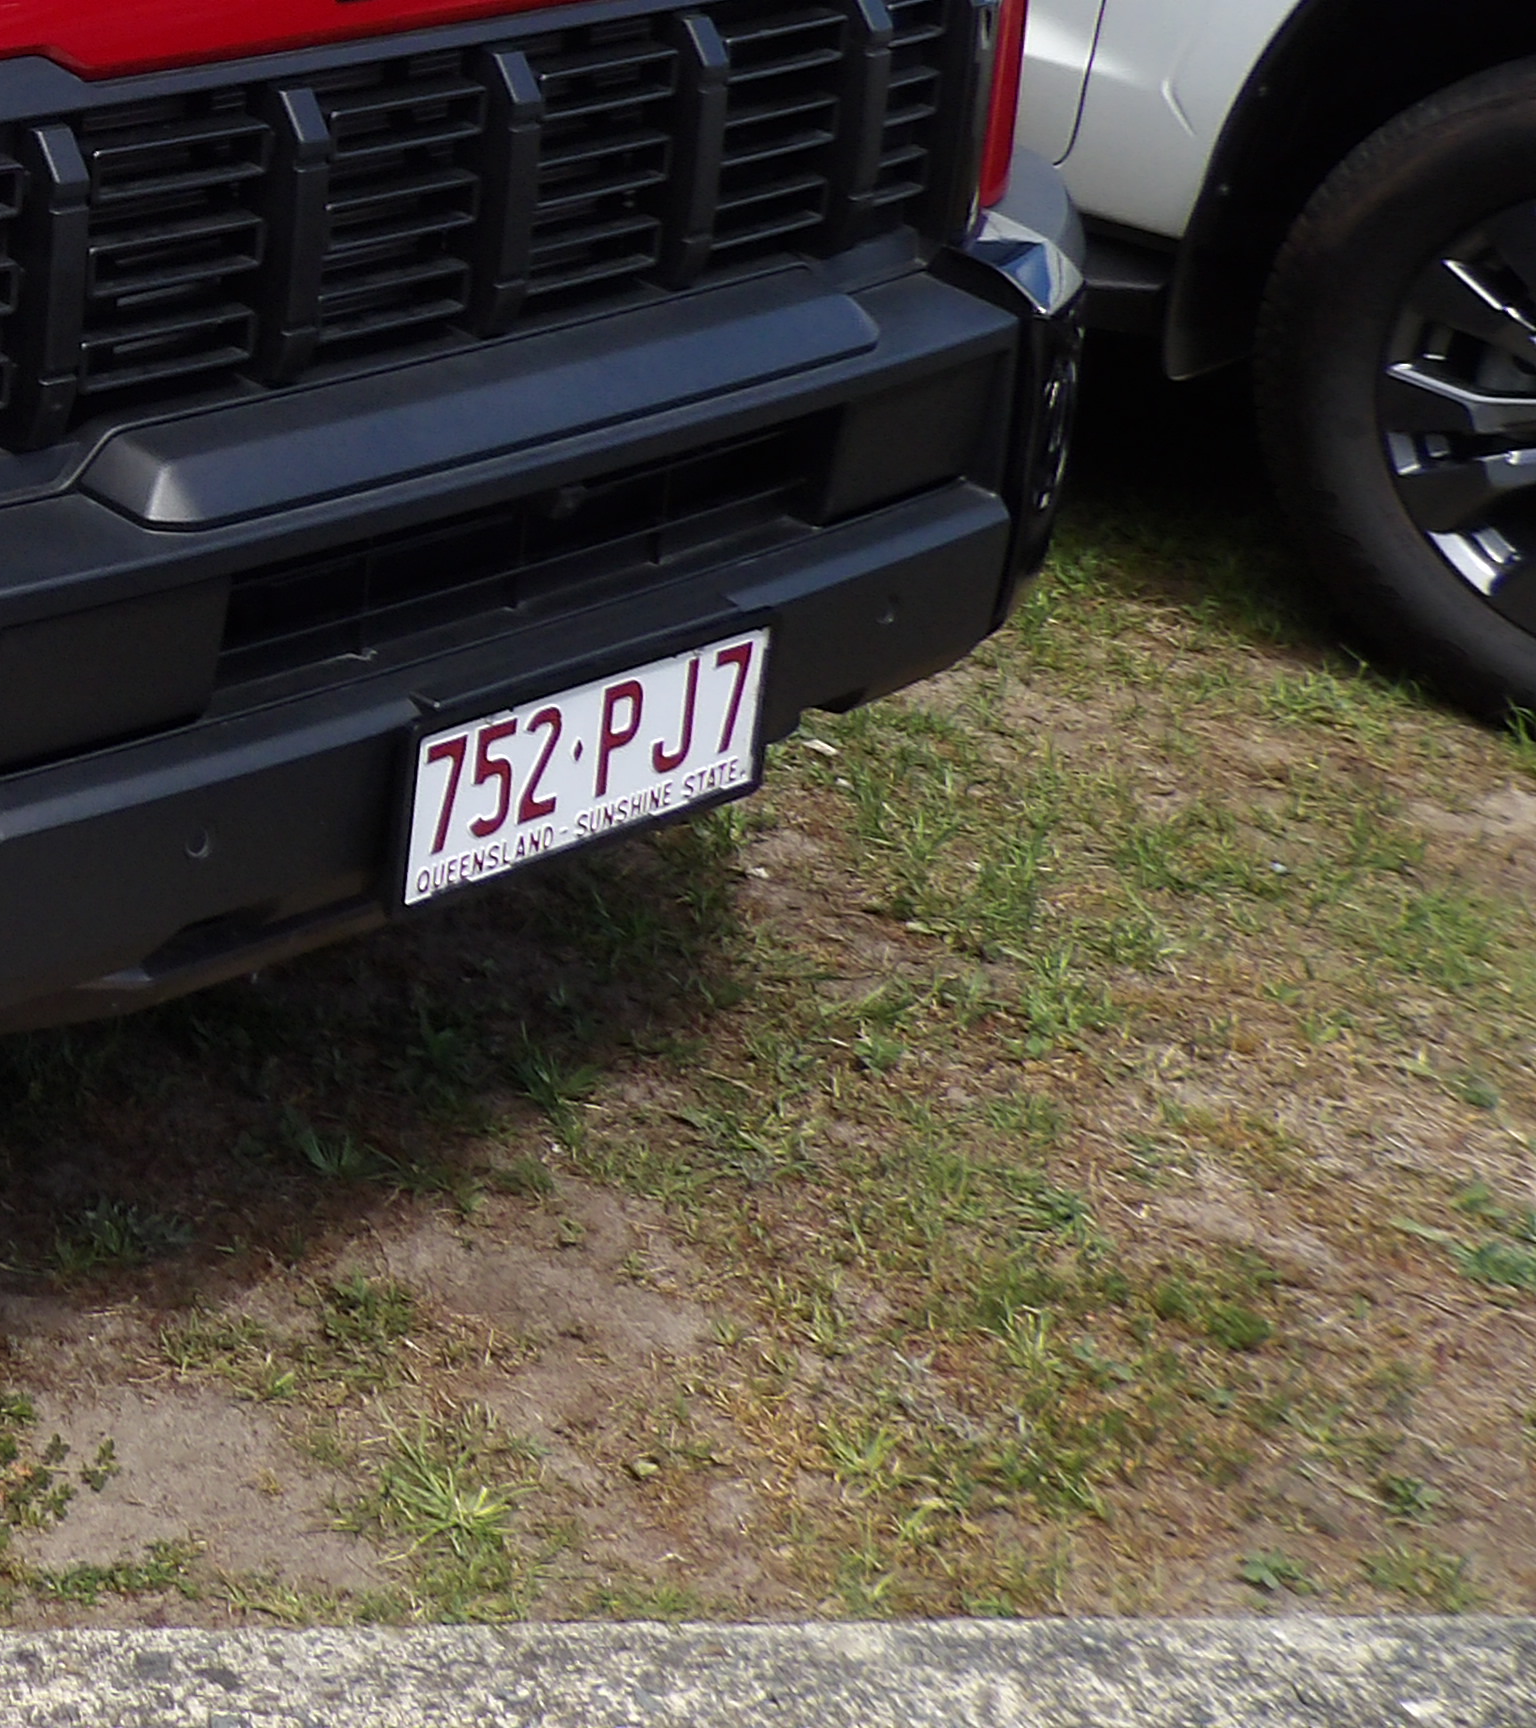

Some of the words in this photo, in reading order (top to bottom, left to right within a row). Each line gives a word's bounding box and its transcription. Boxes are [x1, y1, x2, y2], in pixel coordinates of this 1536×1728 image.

[414, 822, 555, 895] QUEENSLAND
[575, 782, 673, 836] SUNSHINE
[680, 760, 740, 798] STATE
